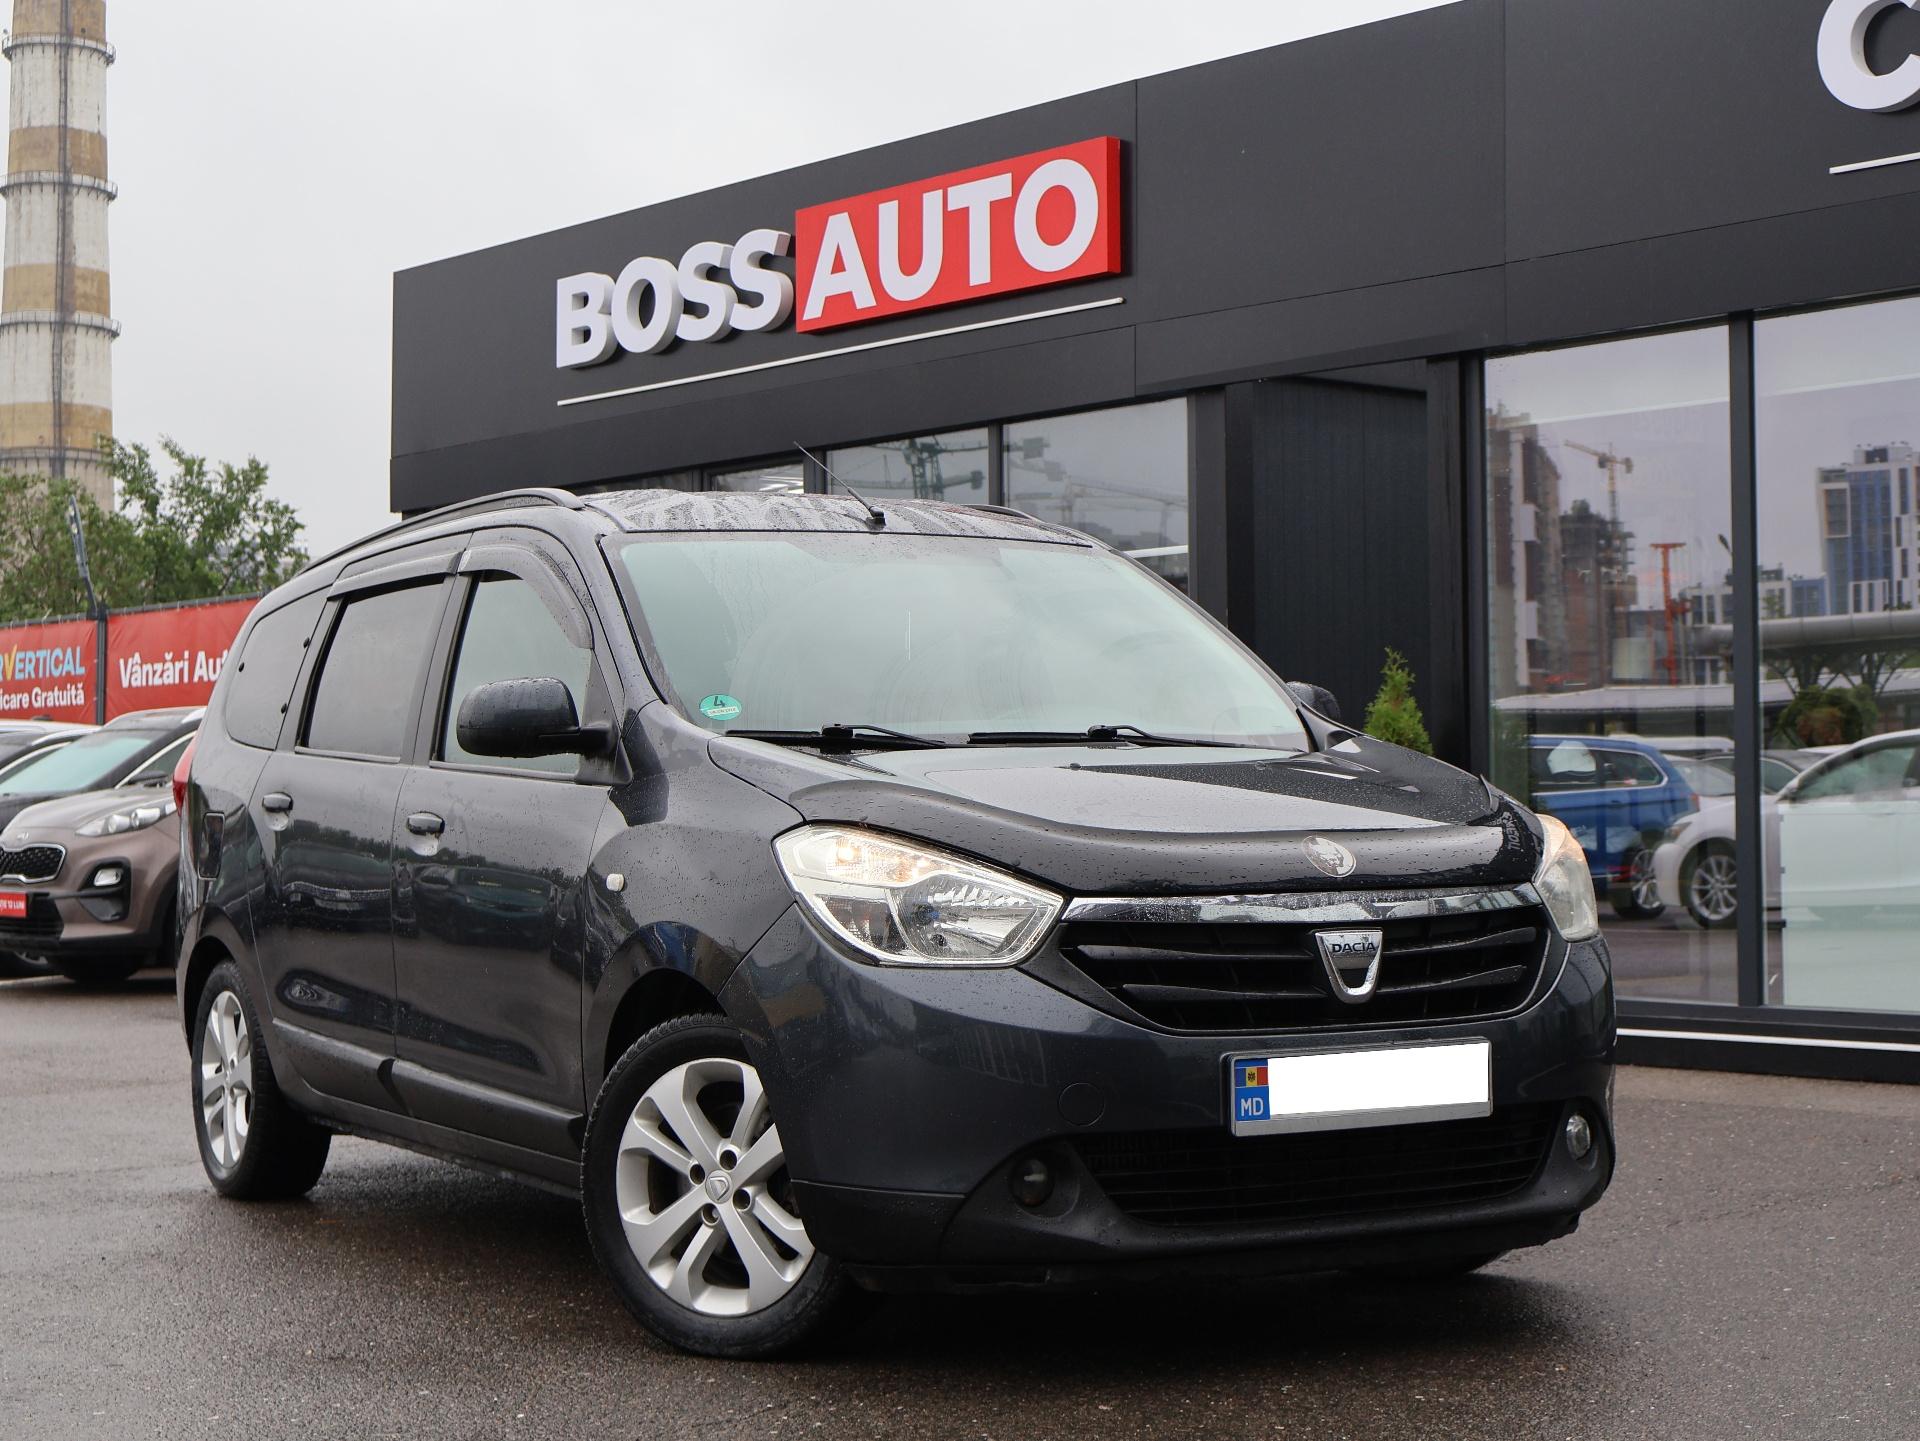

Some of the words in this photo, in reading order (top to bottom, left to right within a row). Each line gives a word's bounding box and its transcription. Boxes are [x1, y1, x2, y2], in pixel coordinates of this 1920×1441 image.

[1817, 0, 1920, 113] C
[557, 229, 793, 368] BOSS
[803, 159, 1099, 320] AUTO
[119, 650, 189, 688] Vânzări
[32, 682, 84, 709] Gratuită
[1332, 942, 1376, 953] DACIA
[1241, 1097, 1264, 1117] MD
